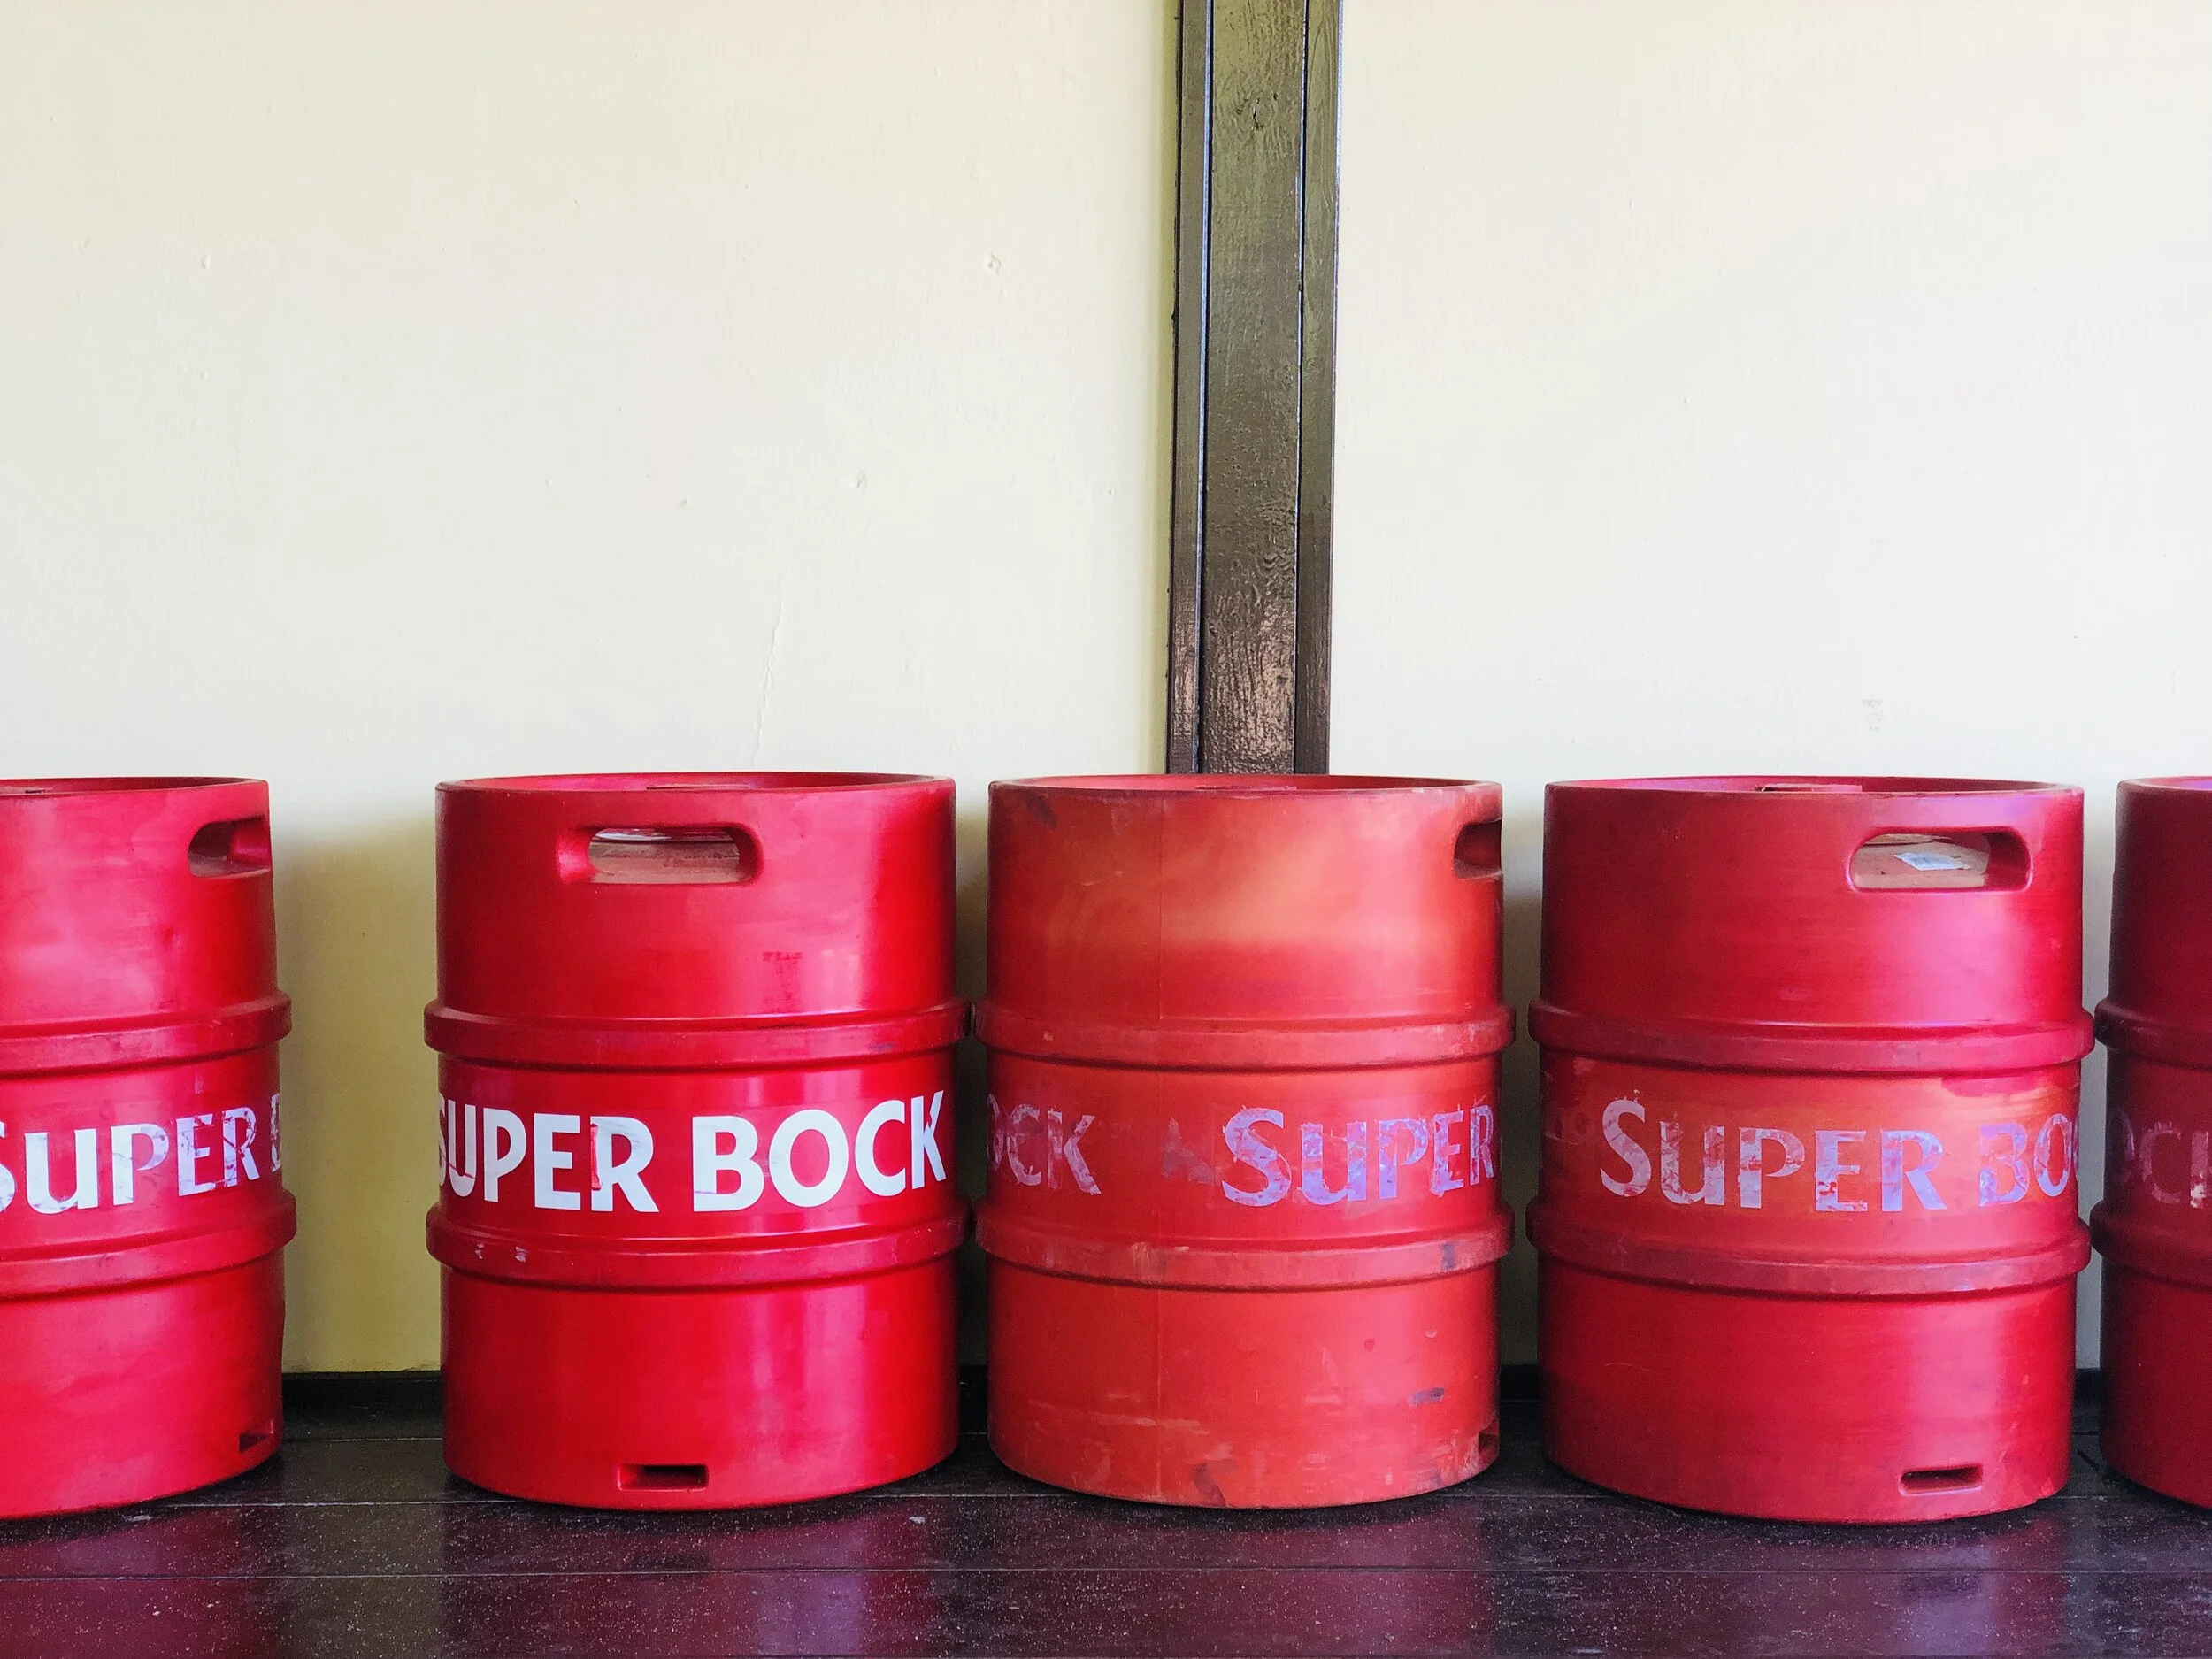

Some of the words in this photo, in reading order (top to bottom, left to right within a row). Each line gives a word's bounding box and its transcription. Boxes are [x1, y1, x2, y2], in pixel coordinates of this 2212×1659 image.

[692, 1090, 947, 1212] BOCK
[1221, 1105, 1495, 1208] SUPER
[1600, 1095, 1947, 1212] SUPER
